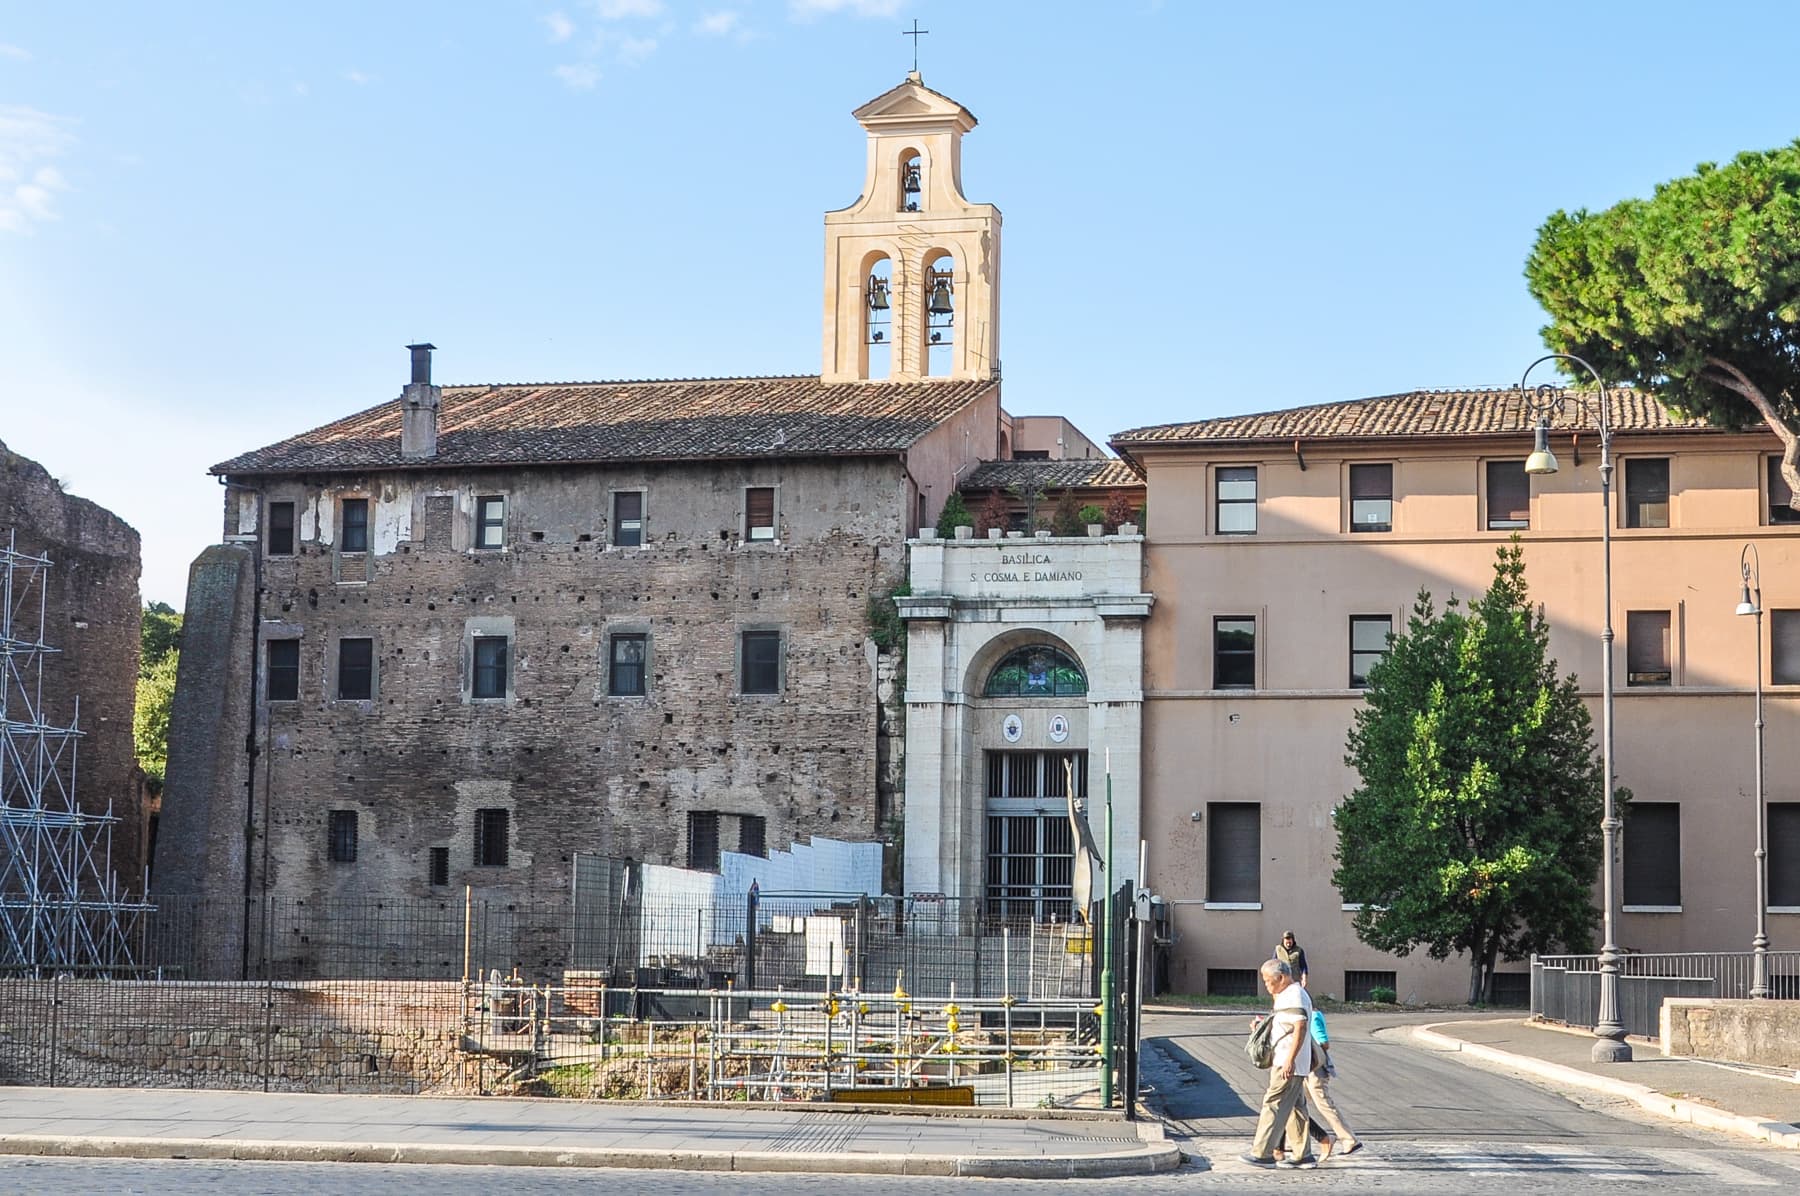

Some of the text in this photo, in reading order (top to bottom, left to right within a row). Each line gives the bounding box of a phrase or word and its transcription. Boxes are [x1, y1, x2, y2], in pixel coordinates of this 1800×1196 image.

[1002, 553, 1051, 565] BASILICA
[984, 573, 1018, 582] COSMA
[1023, 572, 1030, 582] E
[1034, 571, 1082, 582] DAMIANO
